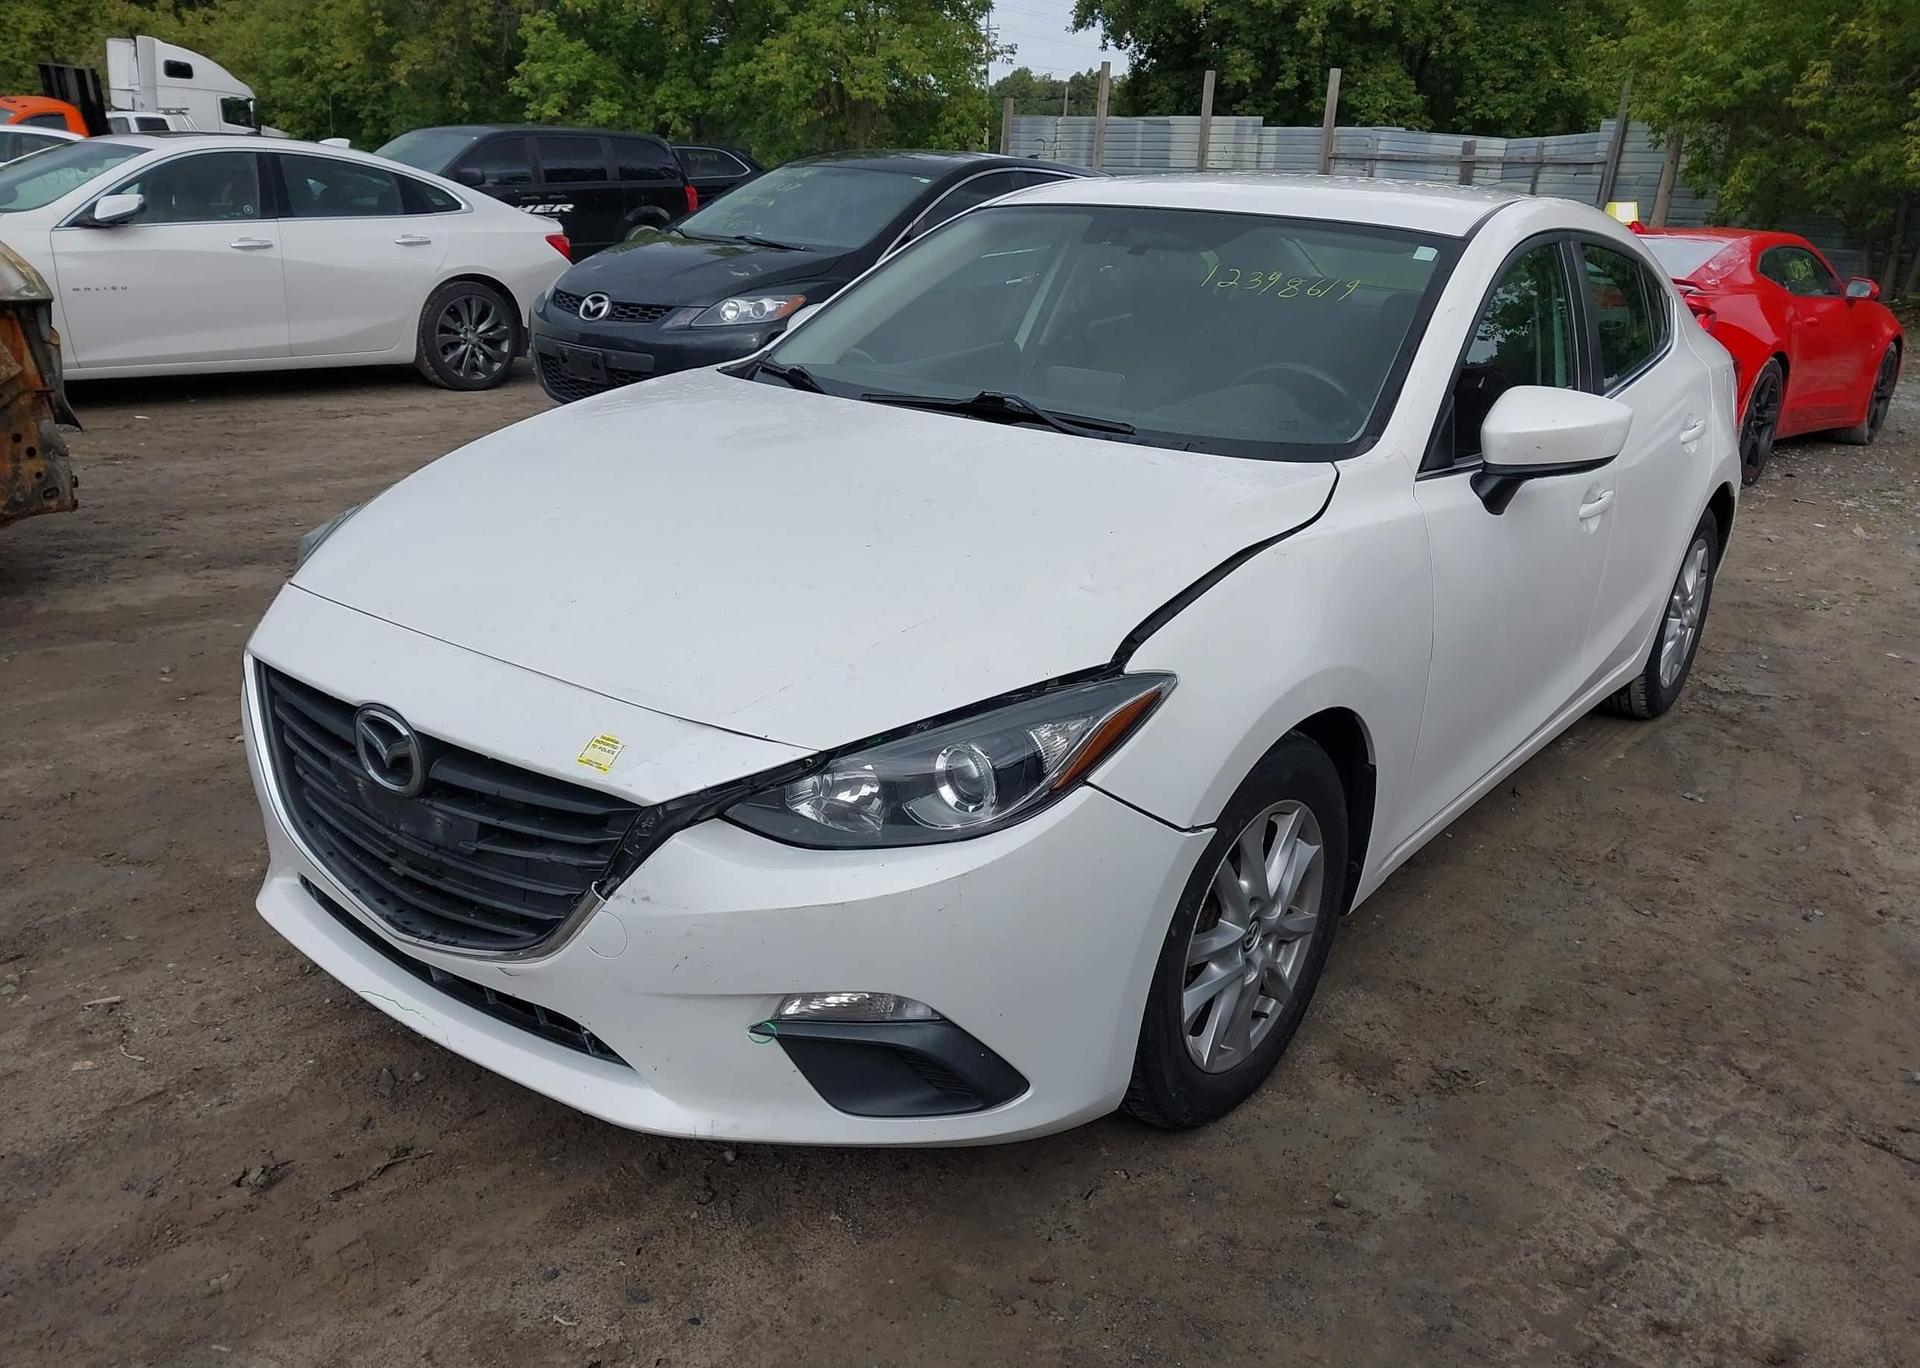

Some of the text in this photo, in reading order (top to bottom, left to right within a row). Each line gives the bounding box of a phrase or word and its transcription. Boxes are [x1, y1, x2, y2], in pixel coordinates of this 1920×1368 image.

[1200, 264, 1361, 302] 12398619
[594, 738, 620, 750] REPORTED
[597, 746, 616, 755] POLICE
